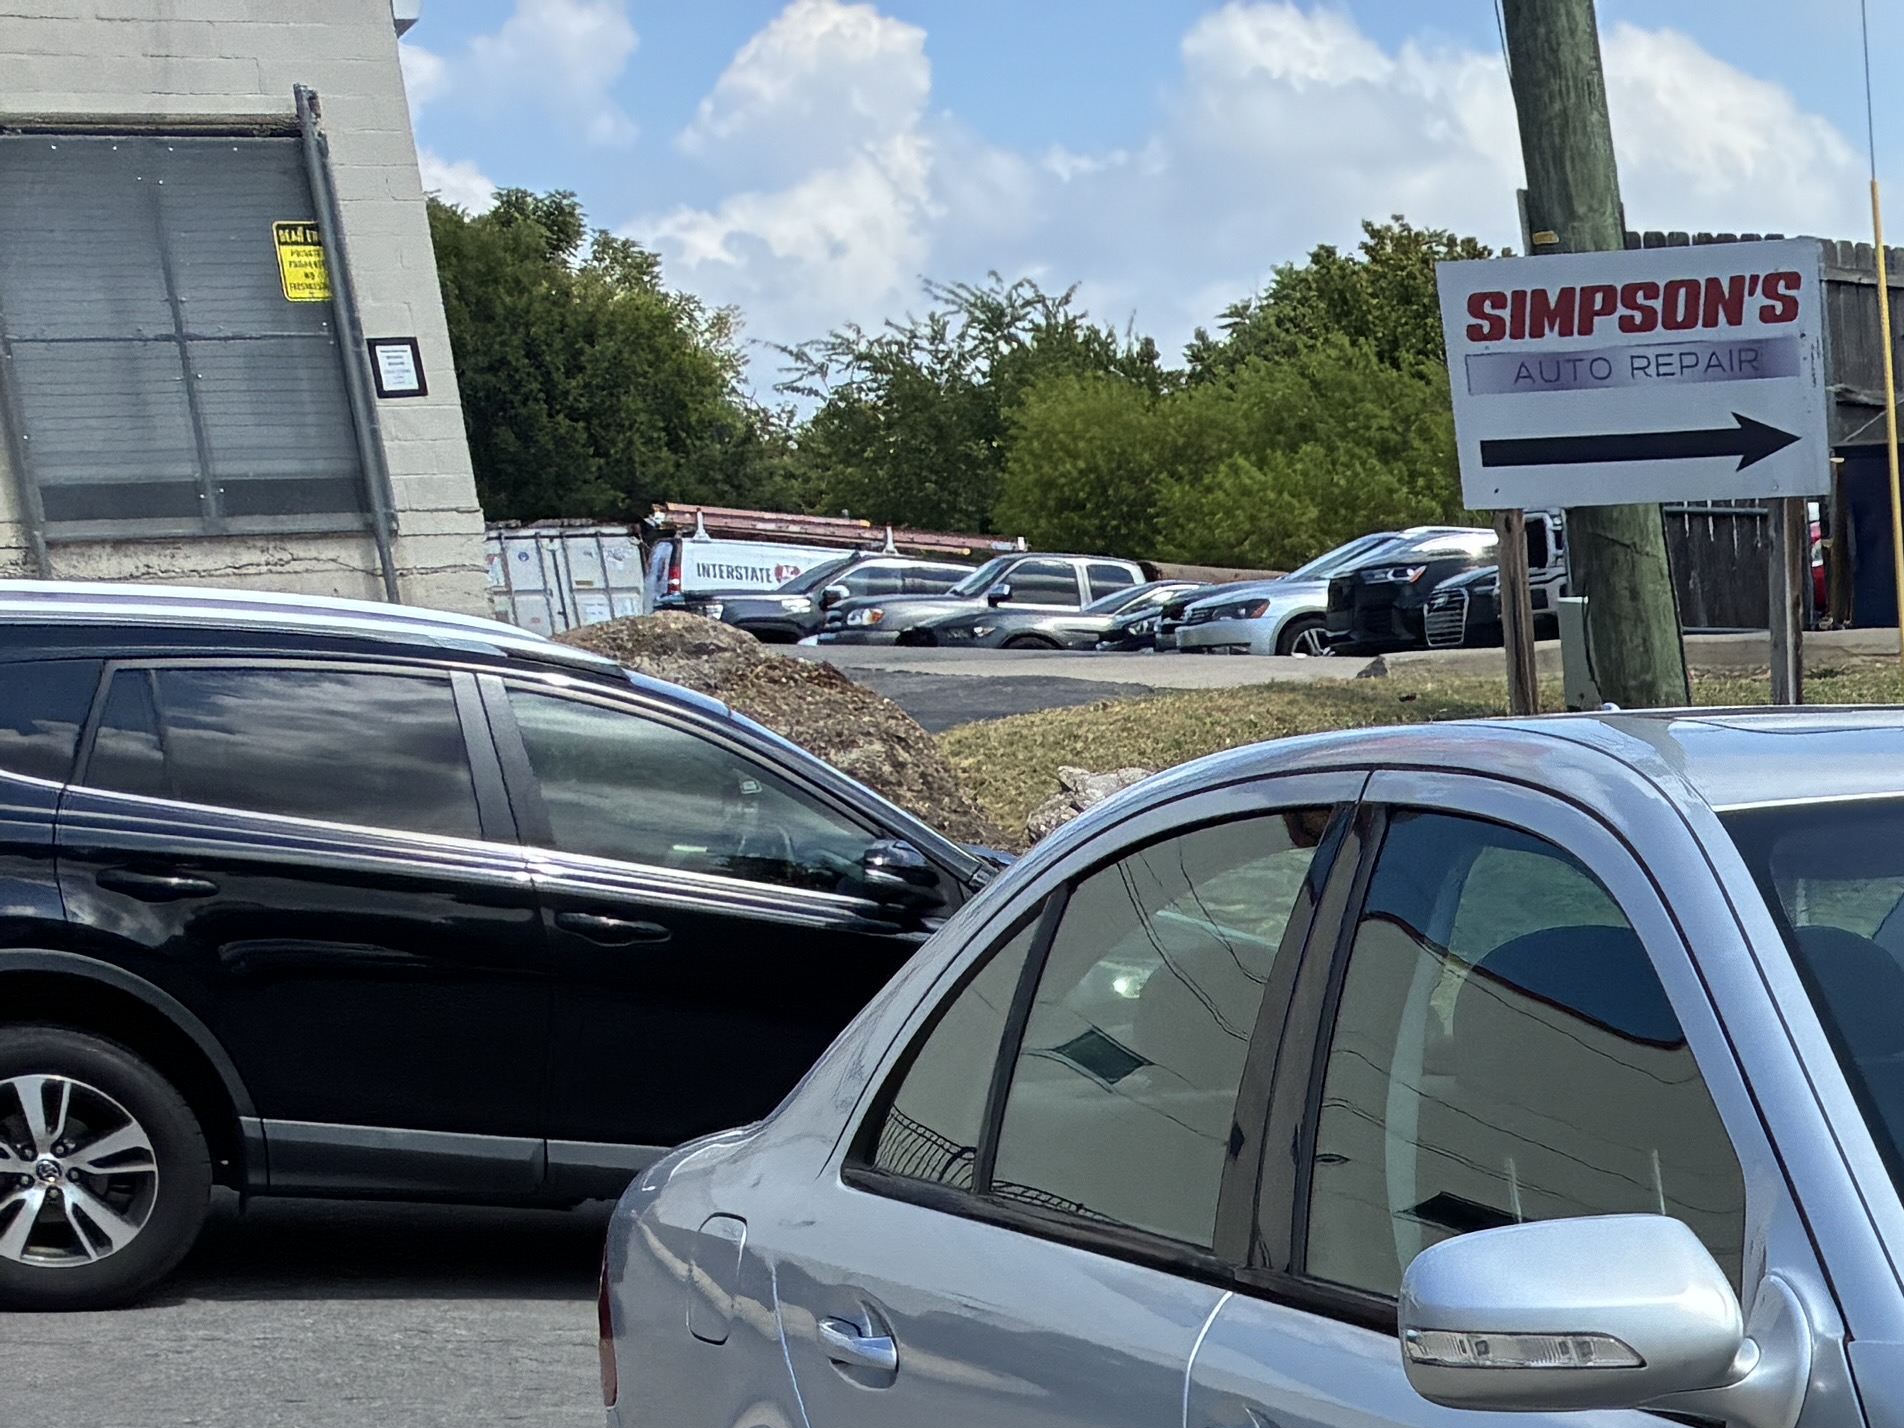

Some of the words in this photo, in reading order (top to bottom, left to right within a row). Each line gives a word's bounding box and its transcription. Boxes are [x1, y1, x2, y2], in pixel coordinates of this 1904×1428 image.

[1466, 271, 1802, 342] SIMPSON'S
[1514, 356, 1612, 385] AUTO
[1630, 348, 1760, 379] REPAIR
[696, 562, 773, 583] INTERSTATE
